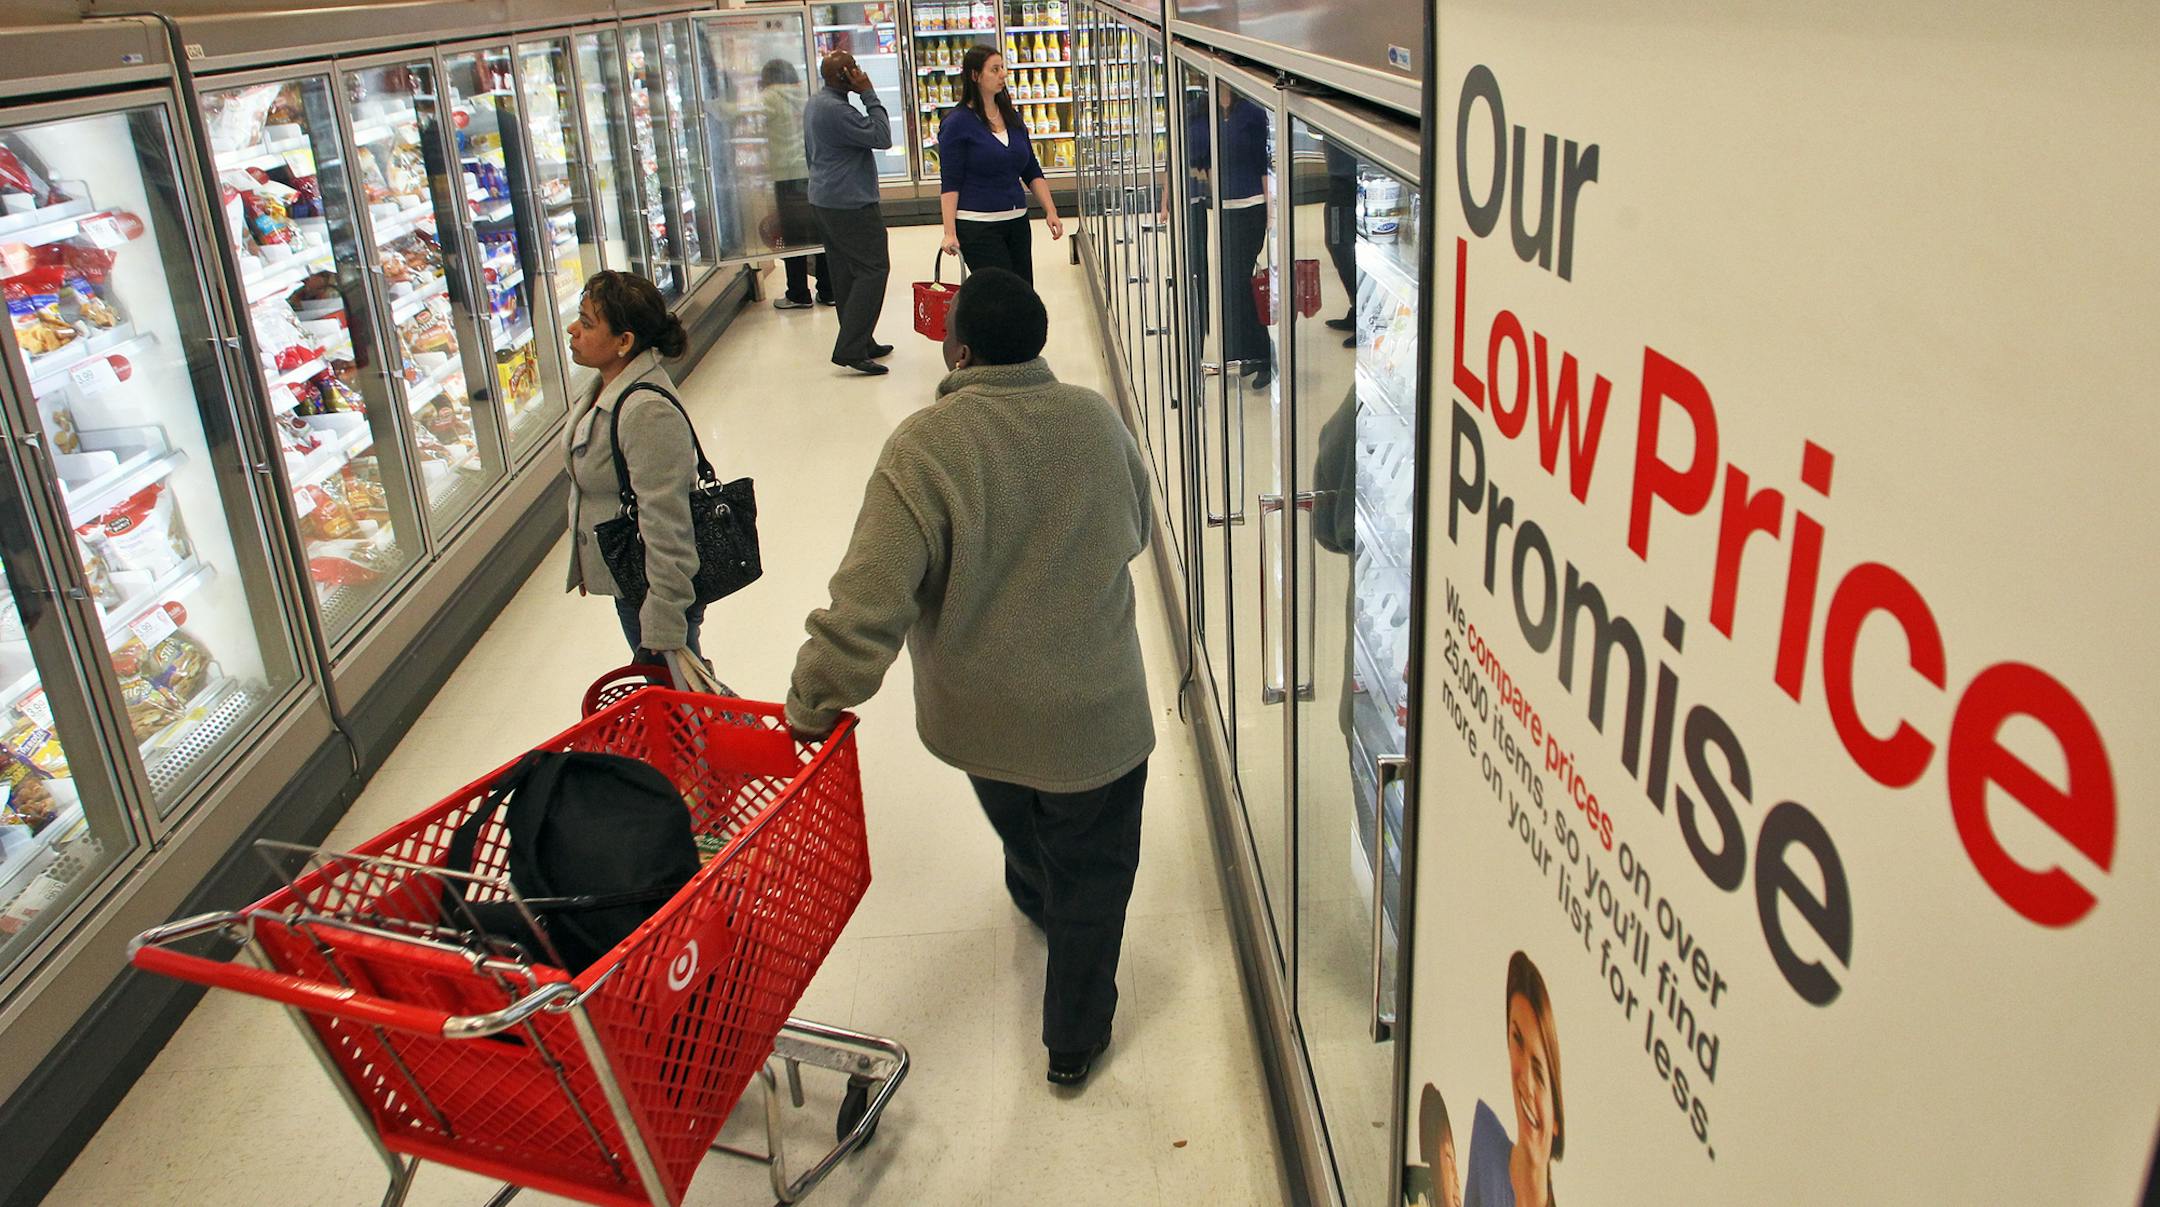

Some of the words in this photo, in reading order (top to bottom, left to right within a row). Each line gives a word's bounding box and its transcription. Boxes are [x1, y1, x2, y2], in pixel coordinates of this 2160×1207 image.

[1456, 64, 1600, 283] Our
[1446, 577, 1466, 636] We
[1468, 623, 1543, 747] compare
[1545, 732, 1613, 851] prices
[1618, 841, 1650, 909] on
[1657, 898, 1727, 1009] over
[1448, 399, 1853, 1008] Promise
[1452, 237, 1613, 506] Low
[1627, 345, 2119, 930] Price
[1443, 679, 1477, 758] more
[1482, 752, 1502, 803] on
[1508, 791, 1552, 876] your
[1557, 864, 1593, 953] list
[1601, 938, 1638, 1021] for
[1645, 1008, 1715, 1162] less.
[1444, 628, 1488, 724] 25,000
[1492, 704, 1548, 825] items,
[1554, 809, 1580, 865] so
[1585, 854, 1650, 977] you'll
[1658, 961, 1720, 1084] find
